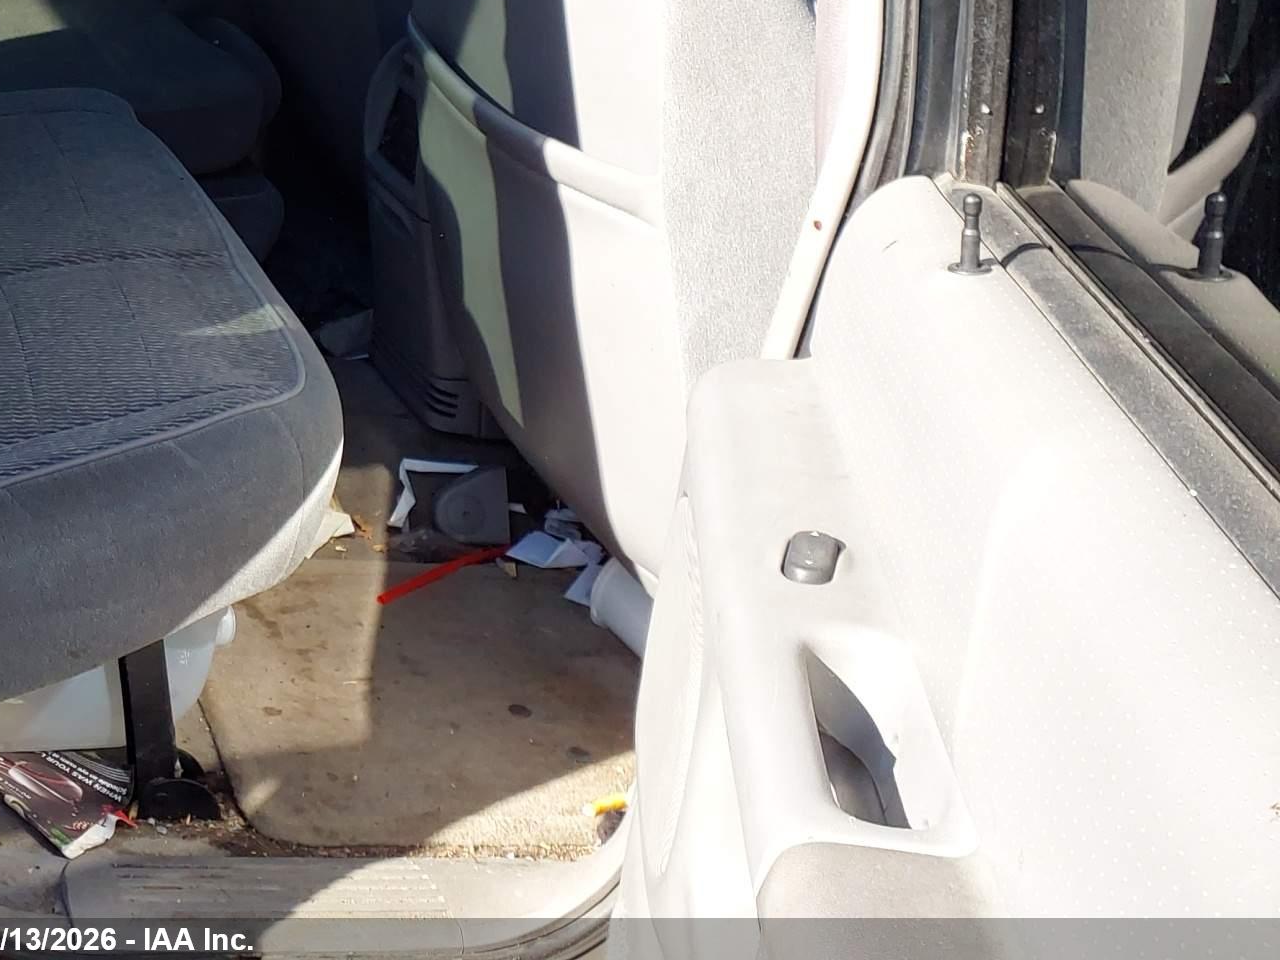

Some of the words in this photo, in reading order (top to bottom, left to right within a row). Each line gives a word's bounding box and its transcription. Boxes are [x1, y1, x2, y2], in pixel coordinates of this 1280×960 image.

[47, 757, 70, 773] YOUR
[72, 772, 93, 786] WAS
[94, 784, 121, 802] WHEN
